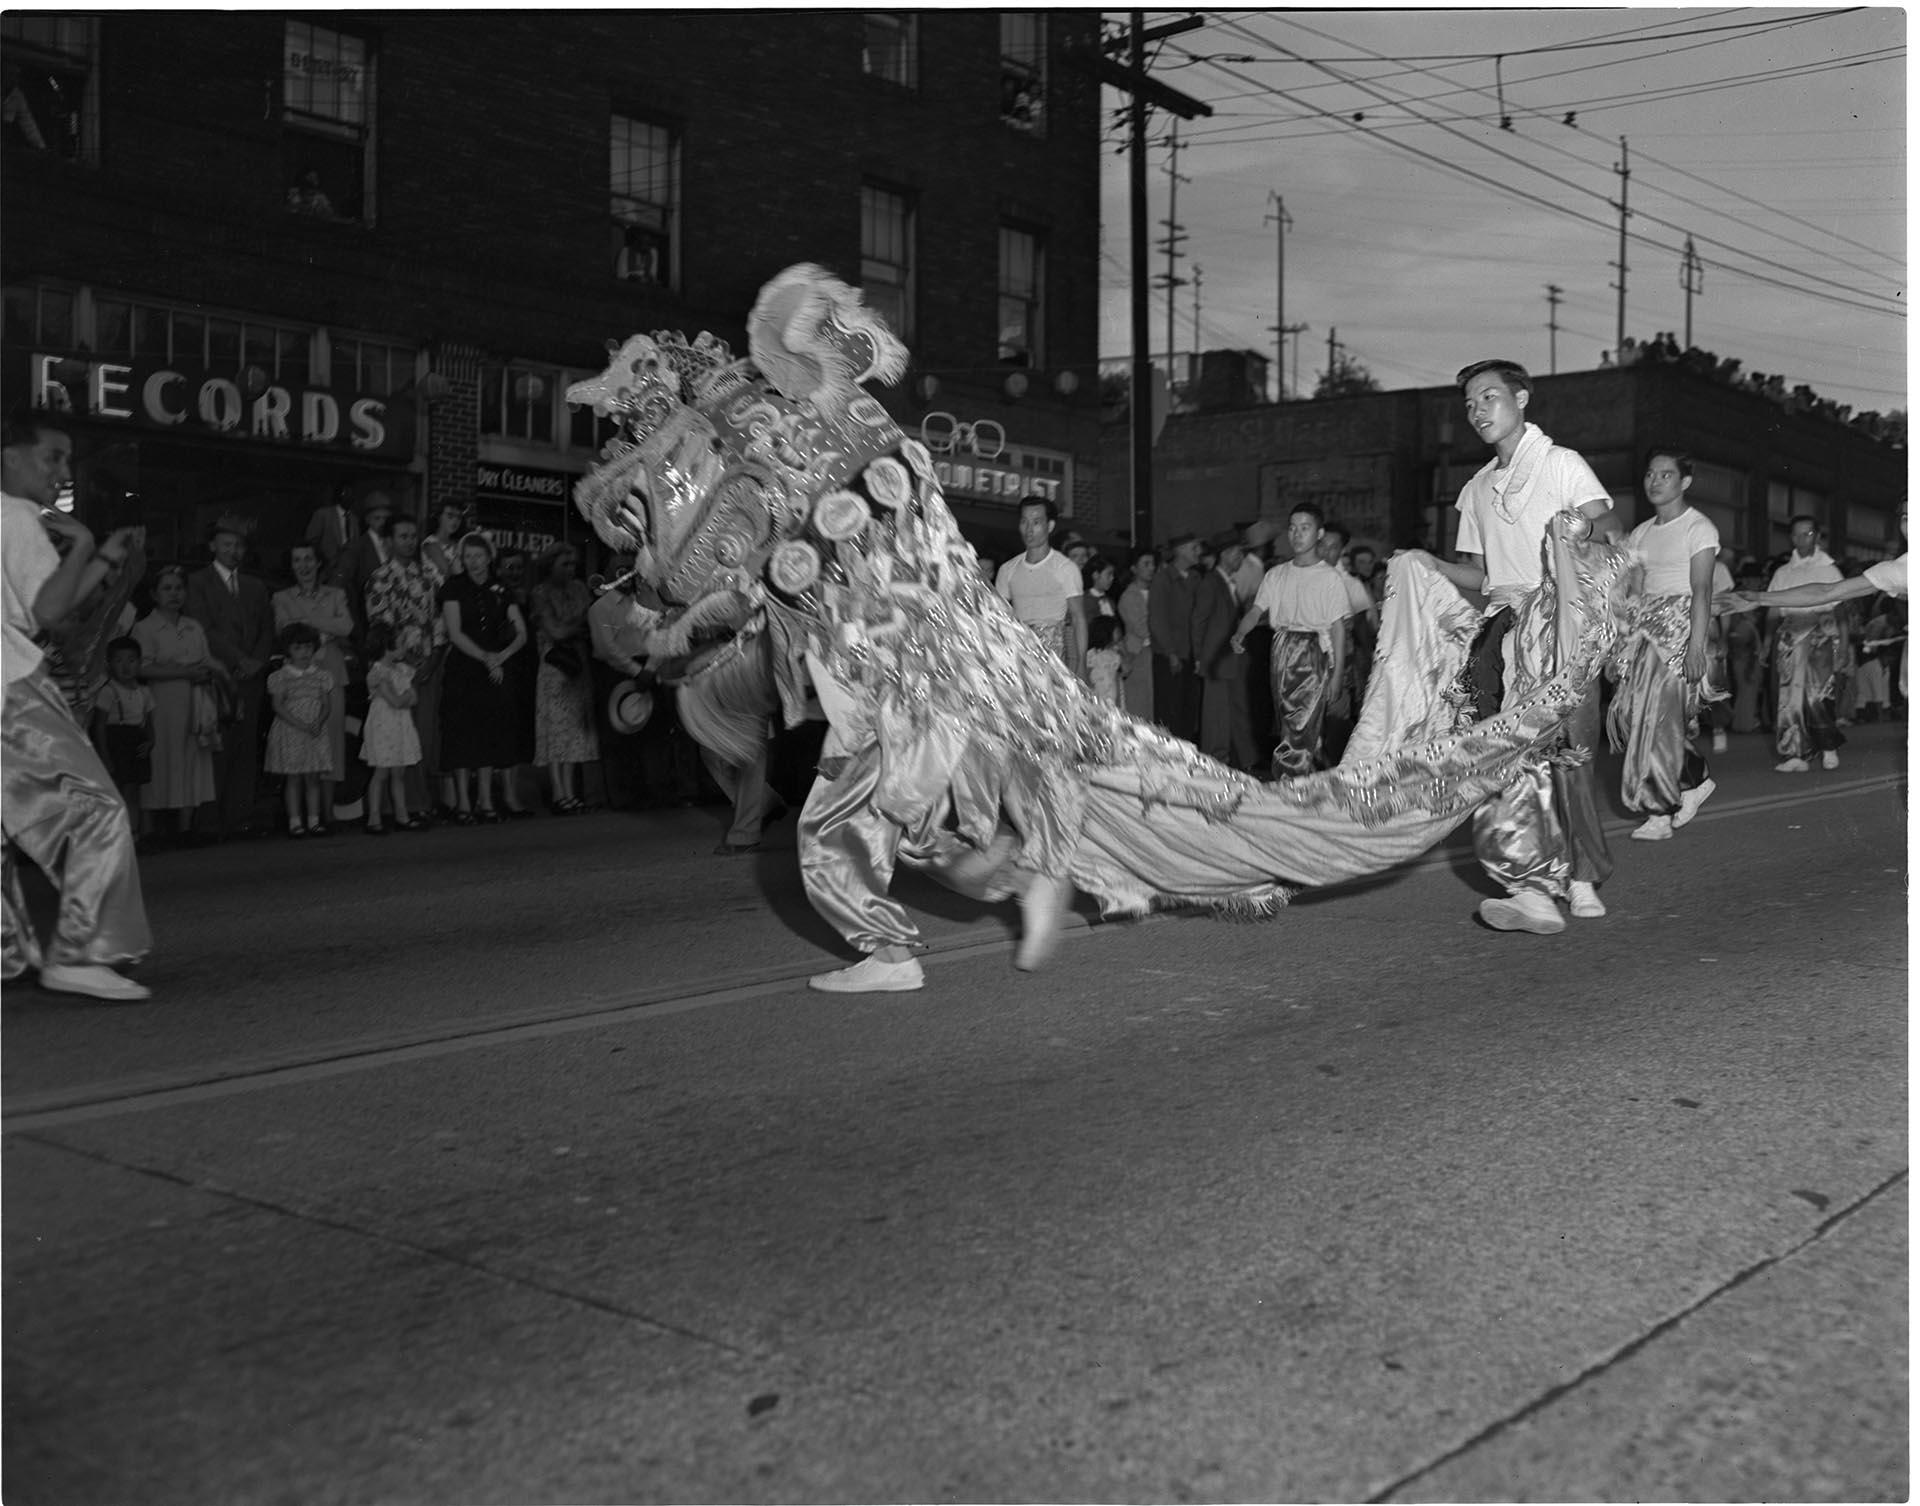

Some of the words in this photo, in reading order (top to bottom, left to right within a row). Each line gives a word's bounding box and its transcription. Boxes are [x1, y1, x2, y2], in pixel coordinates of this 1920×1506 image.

[31, 353, 388, 450] RECORDS
[477, 467, 500, 488] DRY
[501, 468, 564, 496] CLEANERS
